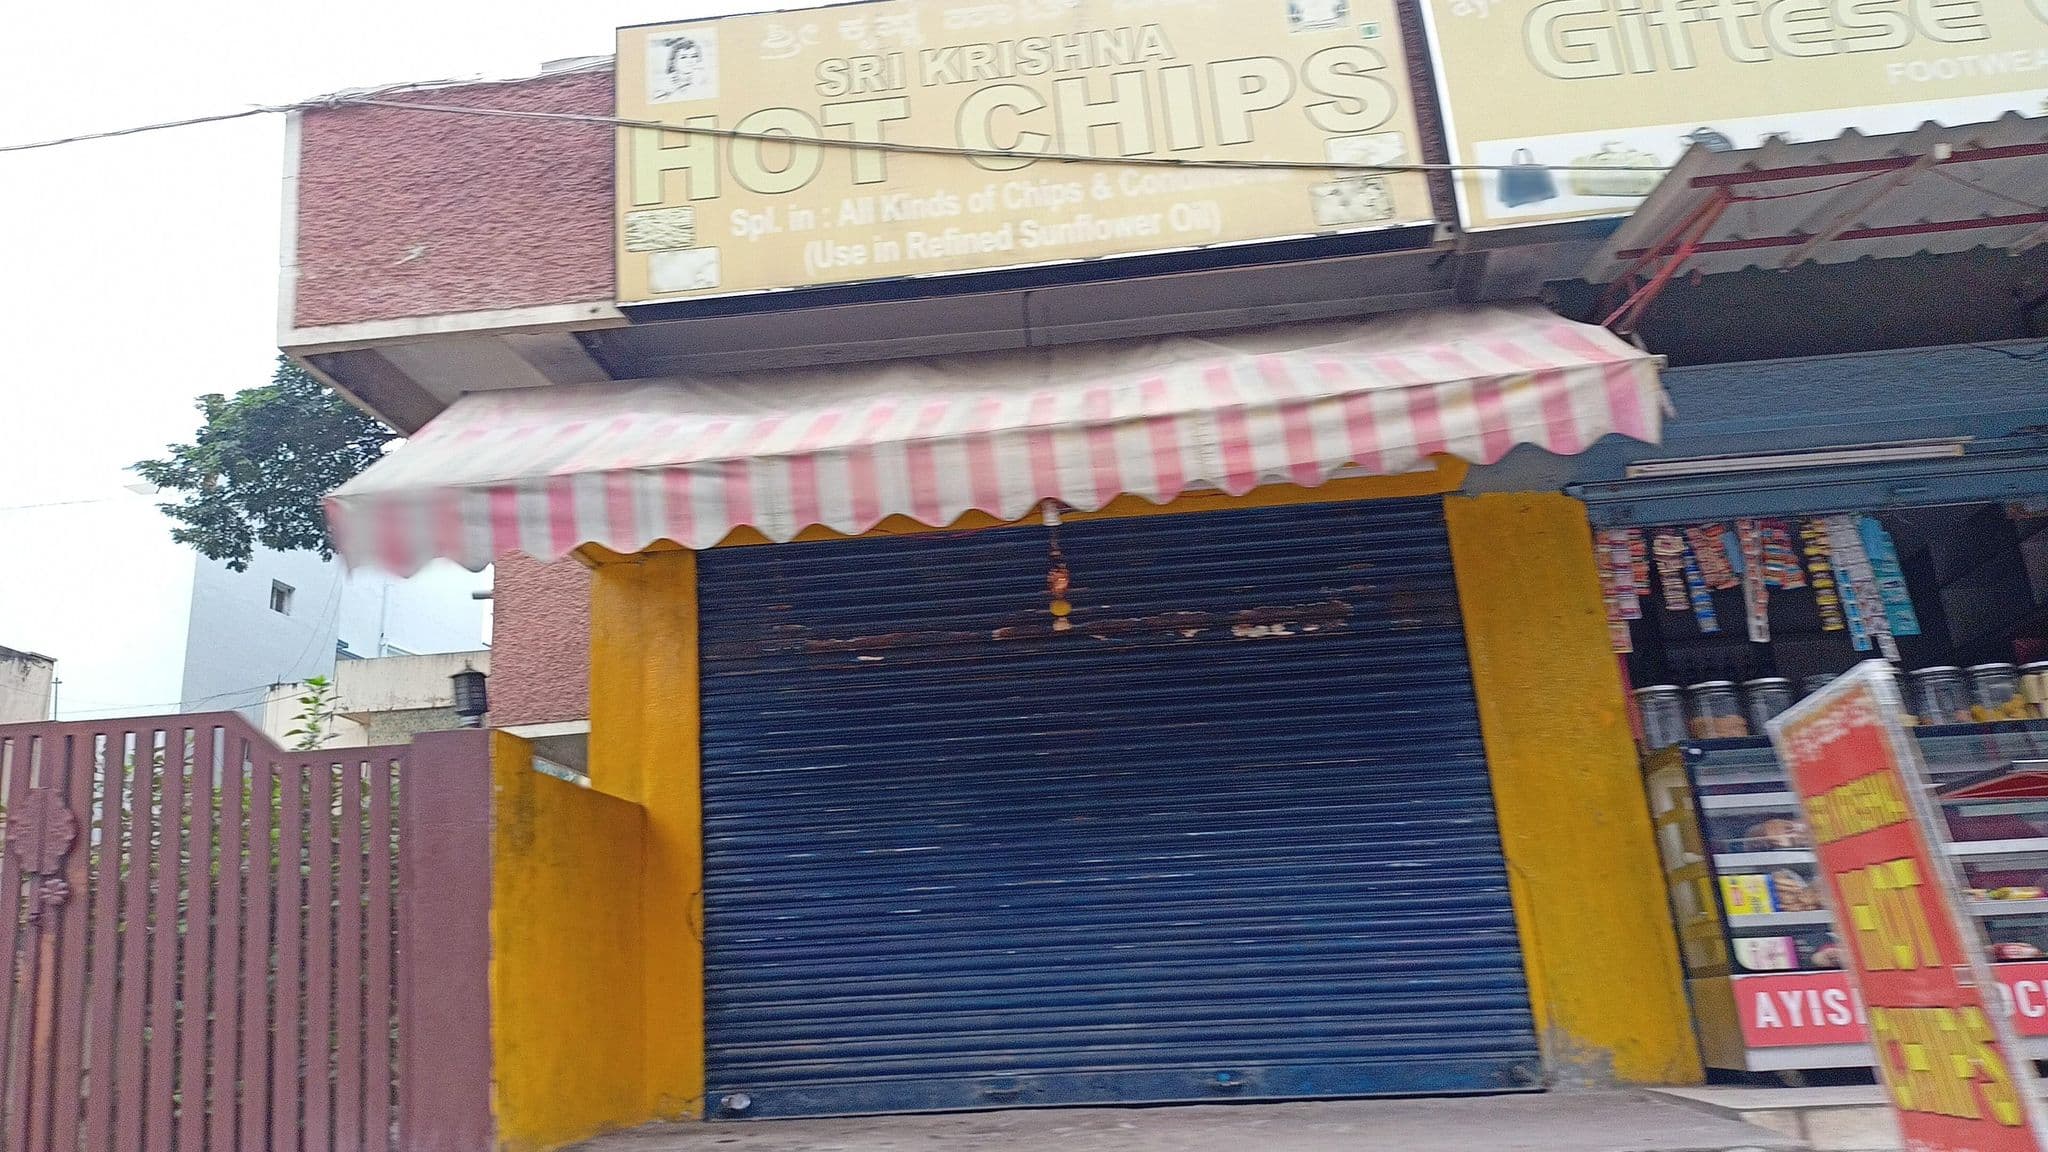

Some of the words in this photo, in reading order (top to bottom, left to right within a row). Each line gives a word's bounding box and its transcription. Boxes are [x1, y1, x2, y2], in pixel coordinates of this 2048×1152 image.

[815, 52, 906, 98] SRI
[920, 23, 1177, 87] KRISHNA
[630, 97, 911, 206] HOT
[955, 45, 1399, 172] CHIPS
[836, 196, 876, 228] All
[880, 190, 961, 222] Kinds
[967, 183, 996, 213] of
[1002, 179, 1084, 213] Chips
[872, 235, 899, 263] in
[906, 222, 1013, 259] Refined
[1020, 212, 1162, 249] Sunflower
